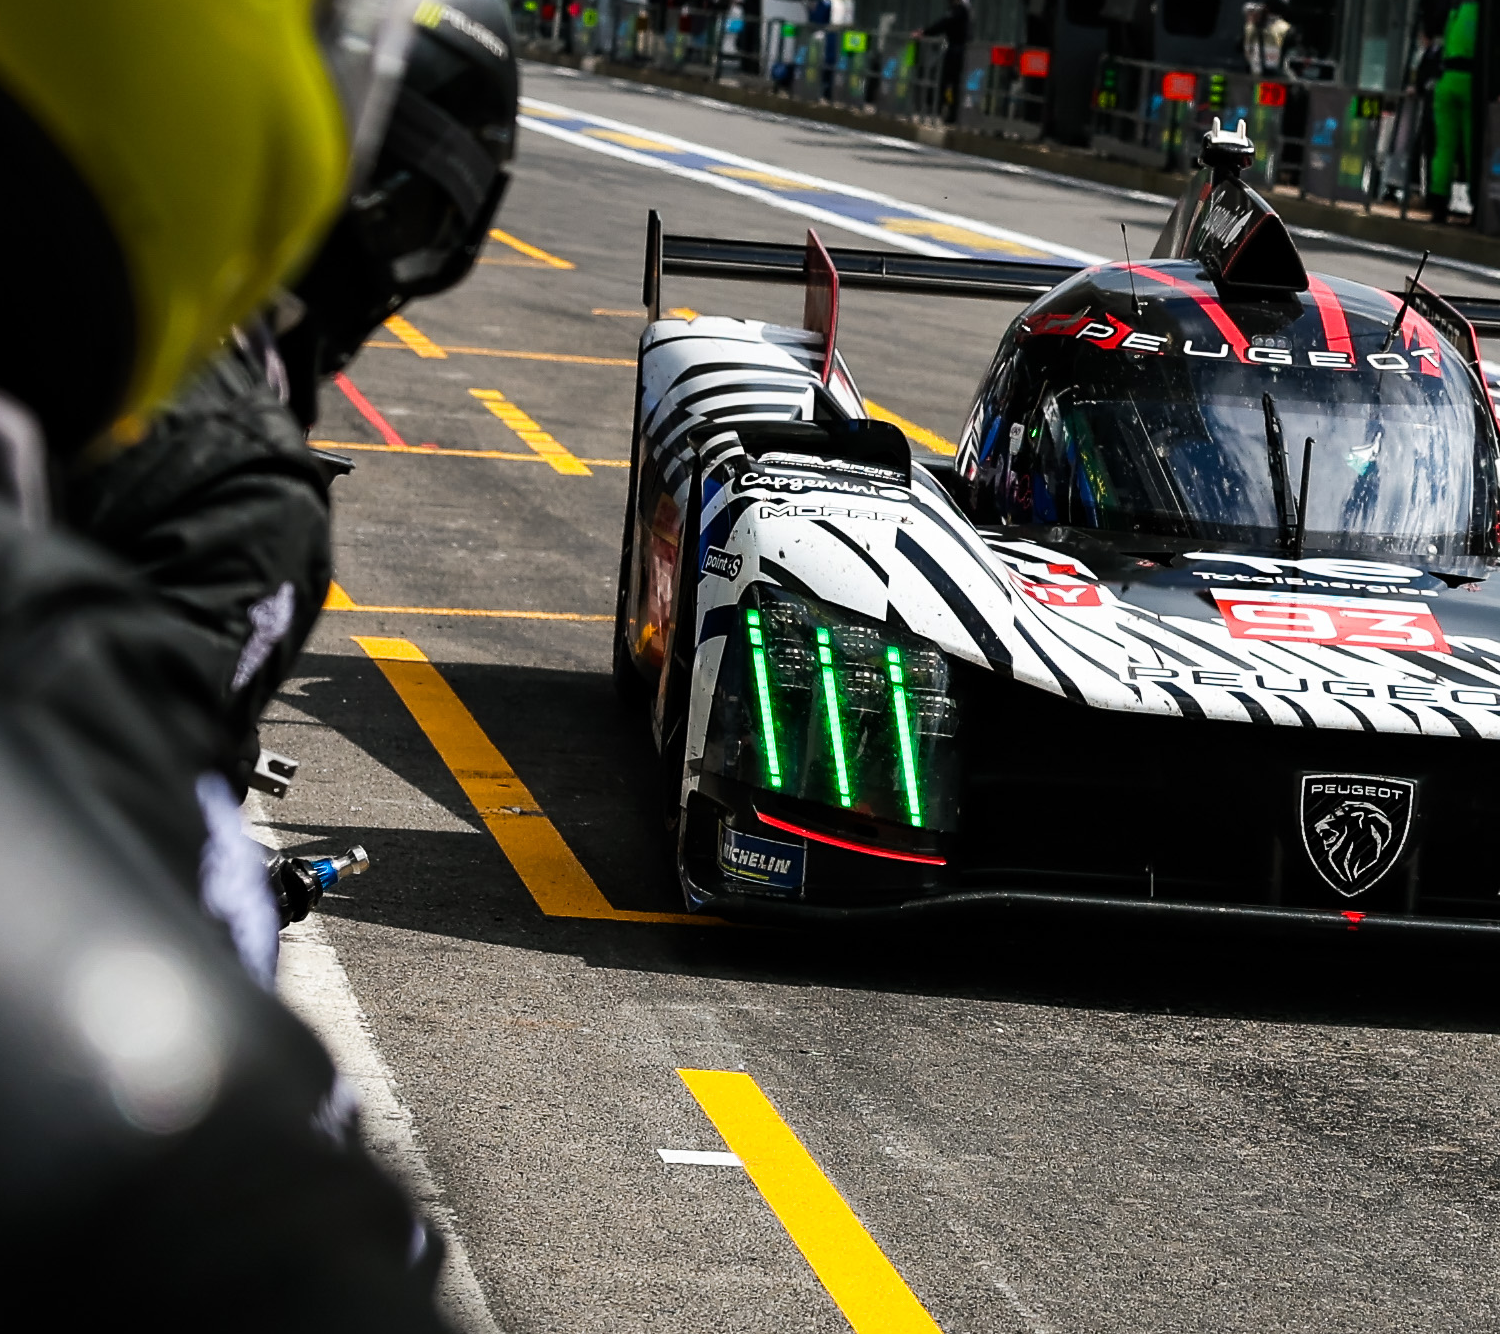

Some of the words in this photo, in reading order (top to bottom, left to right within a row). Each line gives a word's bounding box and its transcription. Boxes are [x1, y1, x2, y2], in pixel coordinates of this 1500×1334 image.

[1075, 322, 1440, 371] PEUGEOT
[740, 471, 879, 497] Capgemini
[759, 505, 910, 525] MOPAR
[1192, 570, 1440, 598] TotalEnergies
[1230, 603, 1436, 648] 93
[1310, 784, 1404, 800] PEUGEOT
